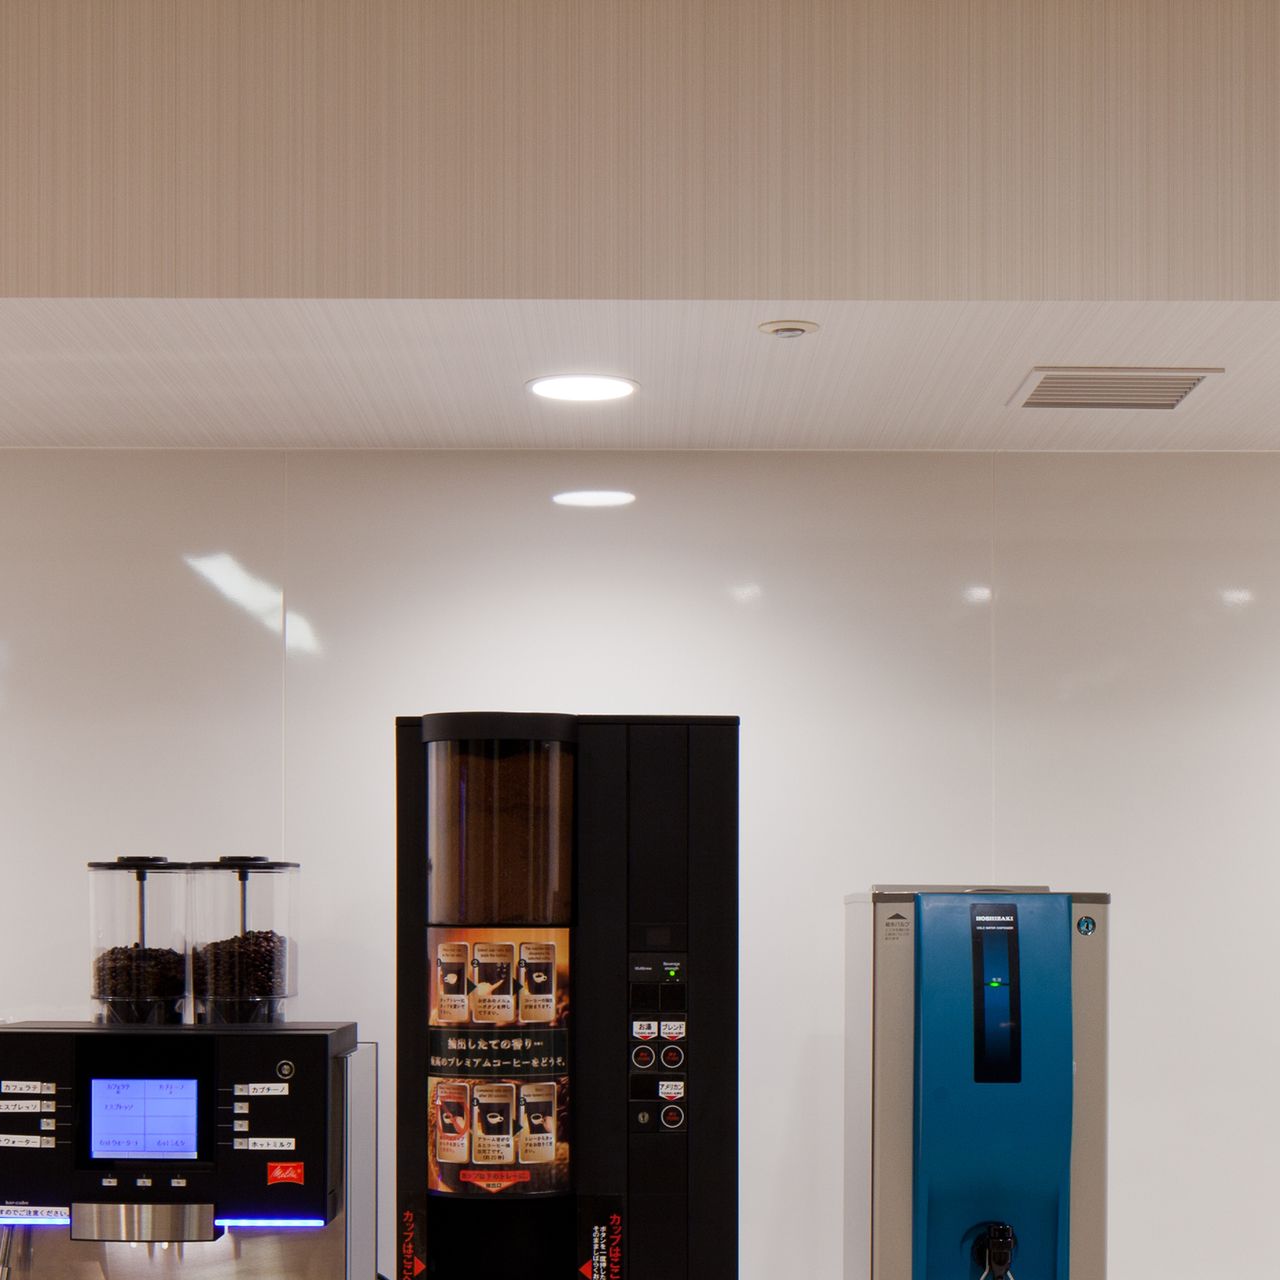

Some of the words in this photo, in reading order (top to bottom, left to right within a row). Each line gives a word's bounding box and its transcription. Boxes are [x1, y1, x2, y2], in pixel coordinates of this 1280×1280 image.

[638, 1023, 652, 1031] お湯
[661, 1023, 684, 1031] ブレンド
[4, 1083, 38, 1092] カフェラテ
[251, 1141, 293, 1149] ホットミルク
